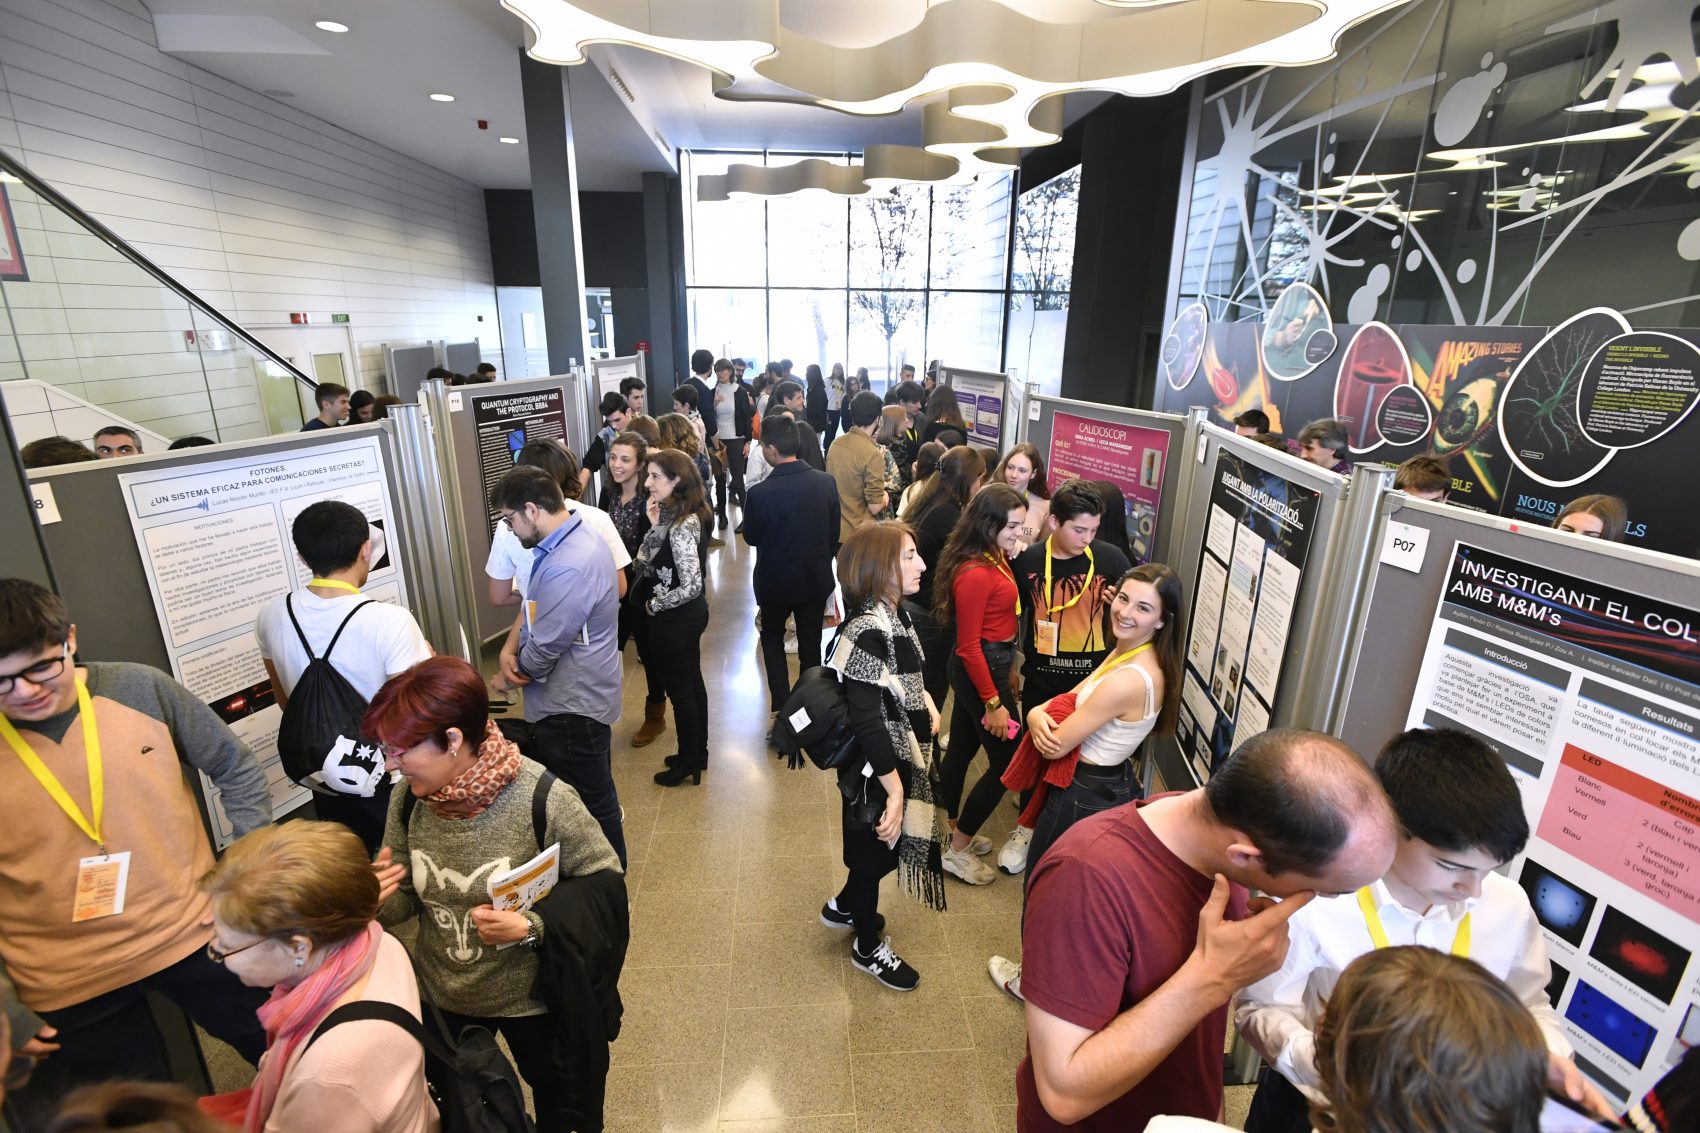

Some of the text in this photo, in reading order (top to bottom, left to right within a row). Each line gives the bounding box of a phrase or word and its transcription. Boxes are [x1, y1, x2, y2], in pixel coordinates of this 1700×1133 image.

[1424, 341, 1523, 399] AMAZING STORIES
[481, 398, 509, 410] QUANTUM
[509, 394, 548, 406] CRYPTOGRAPHY
[496, 401, 548, 415] THE PROTOCOL BB84
[1078, 422, 1126, 441] CALIDOSCOPI
[149, 460, 365, 506] ¿UN SISTEMA EFICAZ PARA COMUNICACIONES SECRETAS?
[1222, 470, 1240, 489] JUGANT
[1239, 480, 1252, 496] AMB
[1250, 487, 1259, 500] LA
[1516, 494, 1556, 514] NOUS
[193, 517, 233, 530] MOTIVACIONES
[1393, 538, 1416, 552] P07
[1450, 578, 1562, 627] AMB M&M's
[1459, 557, 1698, 644] INVESTIGANT EL COL
[1050, 658, 1092, 668] BANANA CLIPS
[1444, 653, 1558, 703] Aquesta investigació va
[1483, 647, 1528, 670] Introducció
[1554, 644, 1566, 654] Zou
[1587, 656, 1608, 668] Institut
[1610, 664, 1641, 680] Salvador
[1436, 685, 1448, 694] que
[1451, 691, 1463, 699] ens
[1475, 700, 1504, 717] semblar
[1438, 676, 1455, 687] base
[1466, 688, 1490, 702] M&M's
[1494, 700, 1515, 713] LEDs
[1516, 709, 1526, 717] de
[1527, 714, 1551, 729] colors
[1442, 661, 1475, 678] començar
[1476, 674, 1502, 690] gràcies
[1539, 701, 1555, 712] que
[1450, 673, 1479, 690] plantejar
[1481, 685, 1490, 693] fer
[1503, 695, 1545, 717] experiment
[1434, 692, 1453, 704] motiu
[1453, 700, 1464, 709] pel
[1464, 705, 1480, 716] qual
[1488, 715, 1511, 730] vàrem
[1512, 726, 1533, 740] posar
[1535, 736, 1545, 745] en
[1573, 709, 1612, 729] comesos
[1614, 725, 1626, 735] en
[1672, 748, 1686, 760] els
[1690, 754, 1700, 766] M
[1576, 699, 1696, 753] La taula següent mostra
[1641, 705, 1693, 734] Resultats
[1571, 717, 1580, 726] la
[1580, 721, 1613, 740] diferent
[1669, 757, 1689, 772] dels
[1692, 766, 1700, 776] L
[1582, 753, 1602, 767] LED
[1573, 785, 1606, 807] Vermell
[1642, 818, 1649, 828] 2
[1650, 822, 1674, 841] (blau
[1576, 774, 1694, 836] Blanc Cap
[1566, 805, 1588, 821] Verd
[1636, 840, 1644, 850] 2
[1645, 844, 1684, 871] (vermell
[1561, 825, 1582, 842] Blau
[1623, 857, 1630, 868] 3
[1632, 861, 1658, 883] (verd,
[1660, 876, 1694, 902] taronja
[1641, 853, 1678, 880] taronja)
[1644, 879, 1670, 901] groc)
